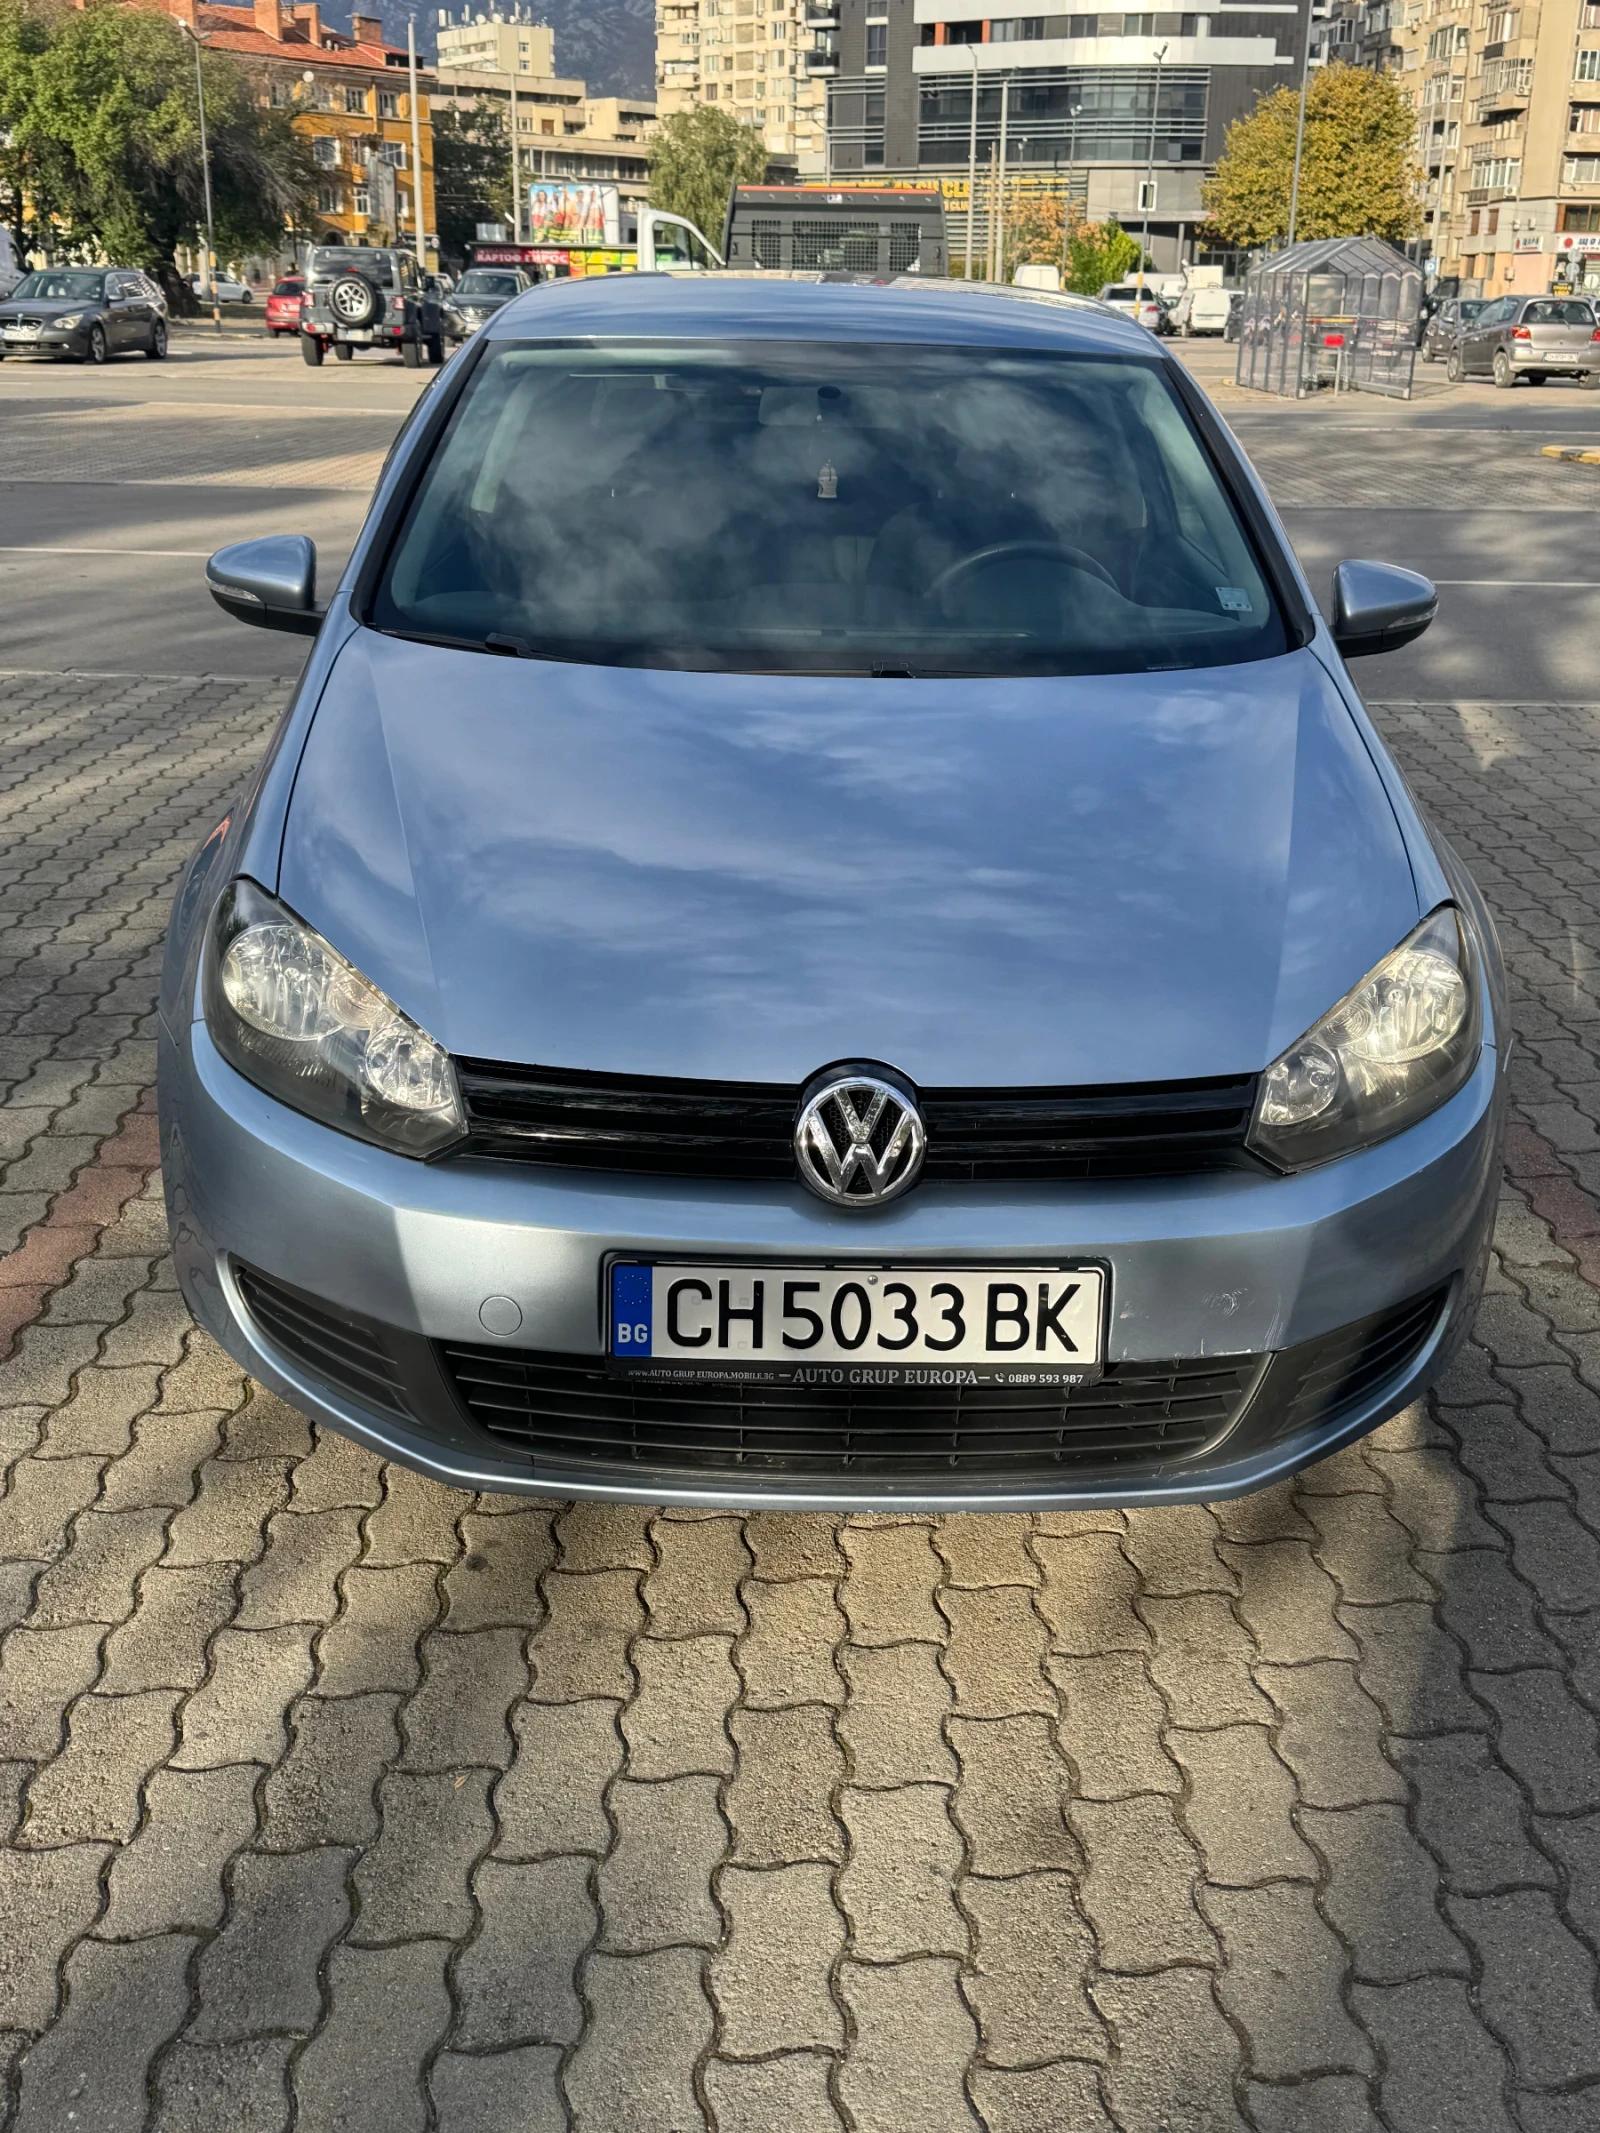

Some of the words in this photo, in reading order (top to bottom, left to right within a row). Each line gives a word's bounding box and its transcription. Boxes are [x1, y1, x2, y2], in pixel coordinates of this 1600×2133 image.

[477, 253, 522, 262] КАРТОФ
[524, 253, 569, 264] ГИРОС
[798, 1080, 922, 1203] VW
[666, 1277, 765, 1349] CH
[782, 1281, 966, 1351] 5033
[985, 1282, 1082, 1352] BK
[617, 1323, 649, 1343] BG
[673, 1370, 696, 1379] GRUP
[792, 1368, 844, 1384] AUTO
[849, 1369, 899, 1384] GRUP
[904, 1369, 978, 1385] EUROPA
[1008, 1373, 1036, 1384] 0889
[1038, 1373, 1060, 1384] 593
[1062, 1373, 1084, 1384] 987
